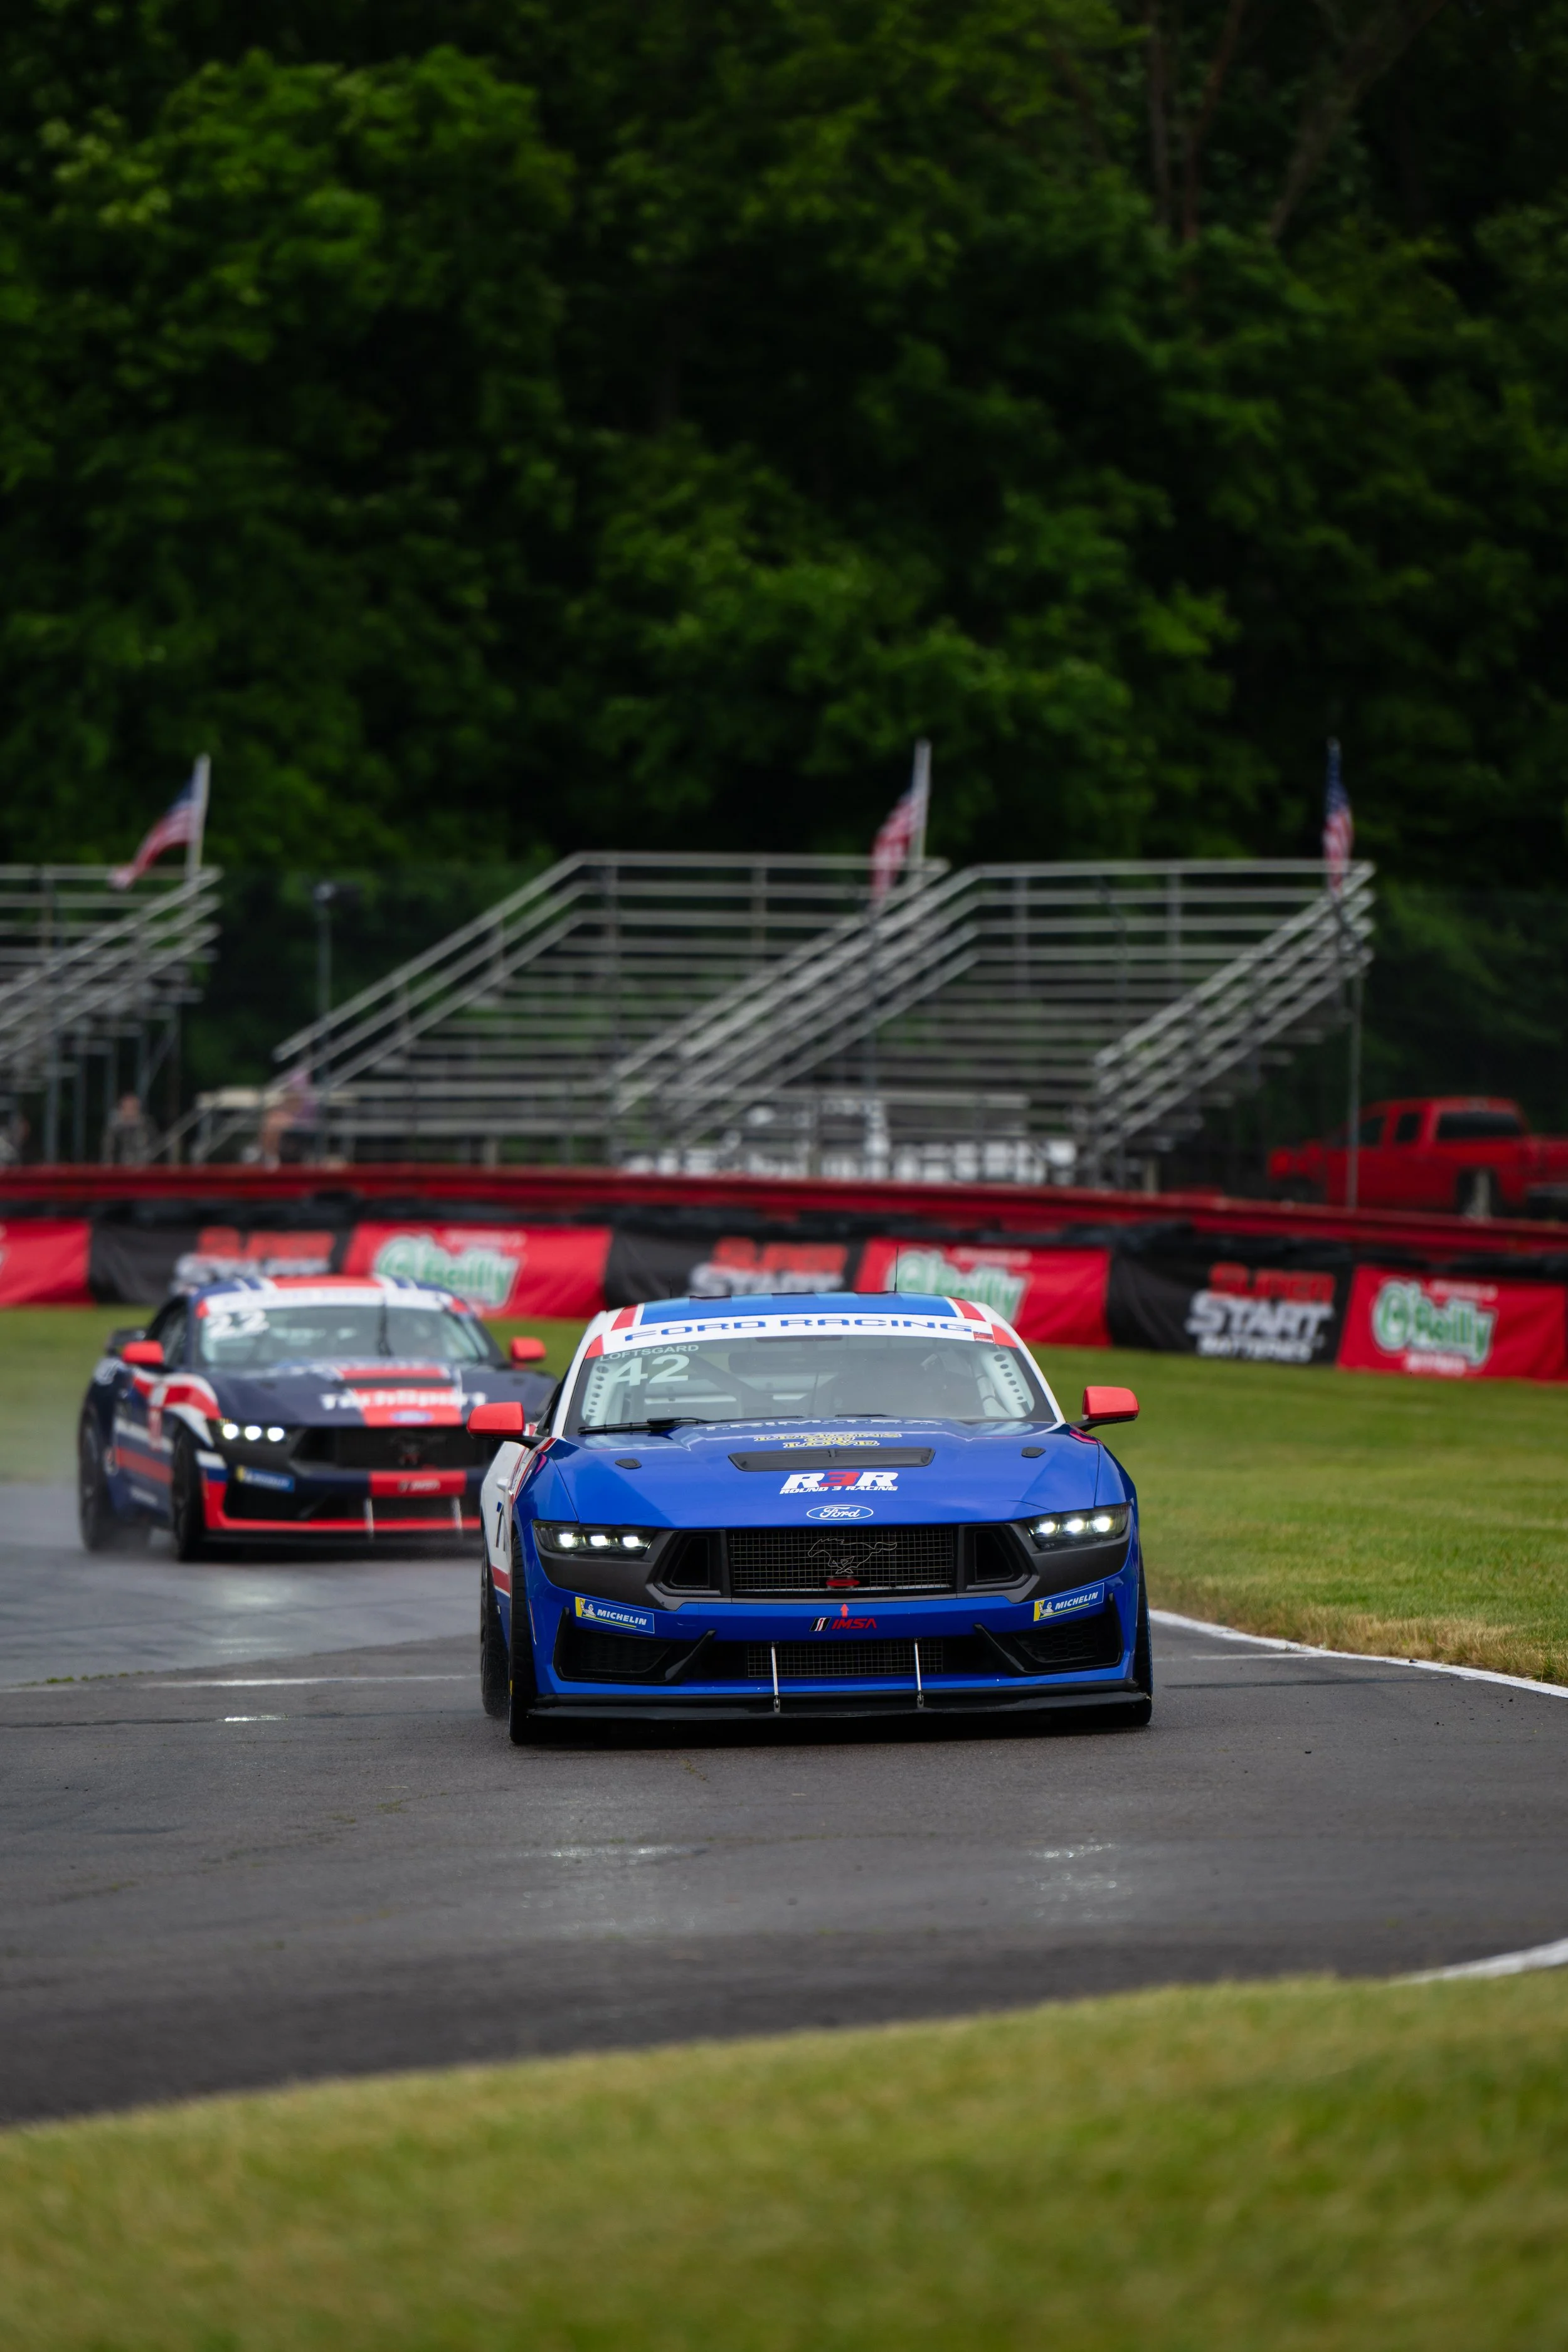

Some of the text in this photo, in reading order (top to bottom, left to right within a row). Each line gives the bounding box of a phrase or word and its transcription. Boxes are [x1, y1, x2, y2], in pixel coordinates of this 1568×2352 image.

[1185, 1290, 1333, 1340] START
[625, 1318, 973, 1341] FORD RACING
[600, 1344, 699, 1362] LOFTSGARD
[613, 1353, 690, 1386] 42
[754, 1432, 903, 1441] LEMONS
[783, 1440, 880, 1448] LOVE
[781, 1471, 898, 1490] R3R
[819, 1507, 861, 1518] Ford
[1055, 1591, 1098, 1610] MICHELIN
[597, 1609, 647, 1625] MICHELIN
[832, 1618, 877, 1629] IMSA
